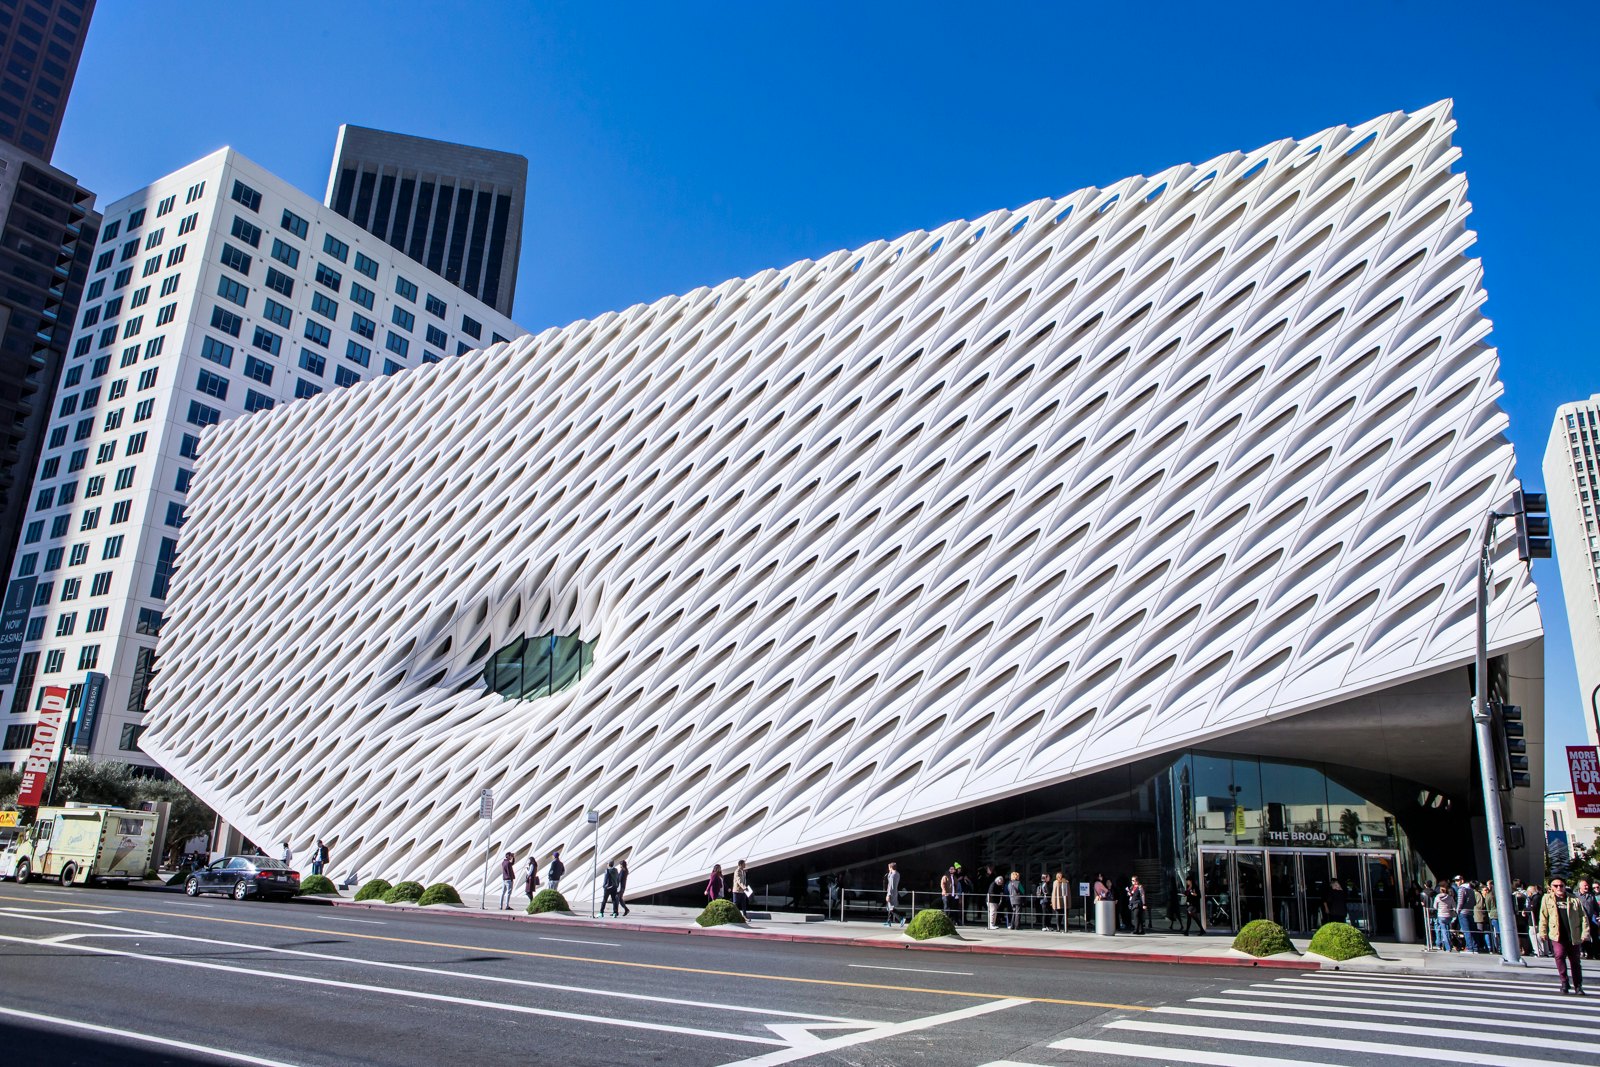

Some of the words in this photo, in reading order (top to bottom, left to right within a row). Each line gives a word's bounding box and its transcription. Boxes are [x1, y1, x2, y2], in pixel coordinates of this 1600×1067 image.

[5, 619, 22, 630] NOW
[0, 632, 23, 644] EASING
[87, 686, 98, 716] EMERSON
[84, 717, 92, 730] THE
[25, 695, 65, 773] BROAD
[1569, 751, 1596, 760] MORE
[1571, 760, 1597, 771] ART
[19, 772, 36, 794] THE
[1572, 771, 1600, 783] FOR
[1269, 831, 1289, 840] THE
[1291, 832, 1327, 841] BROAD
